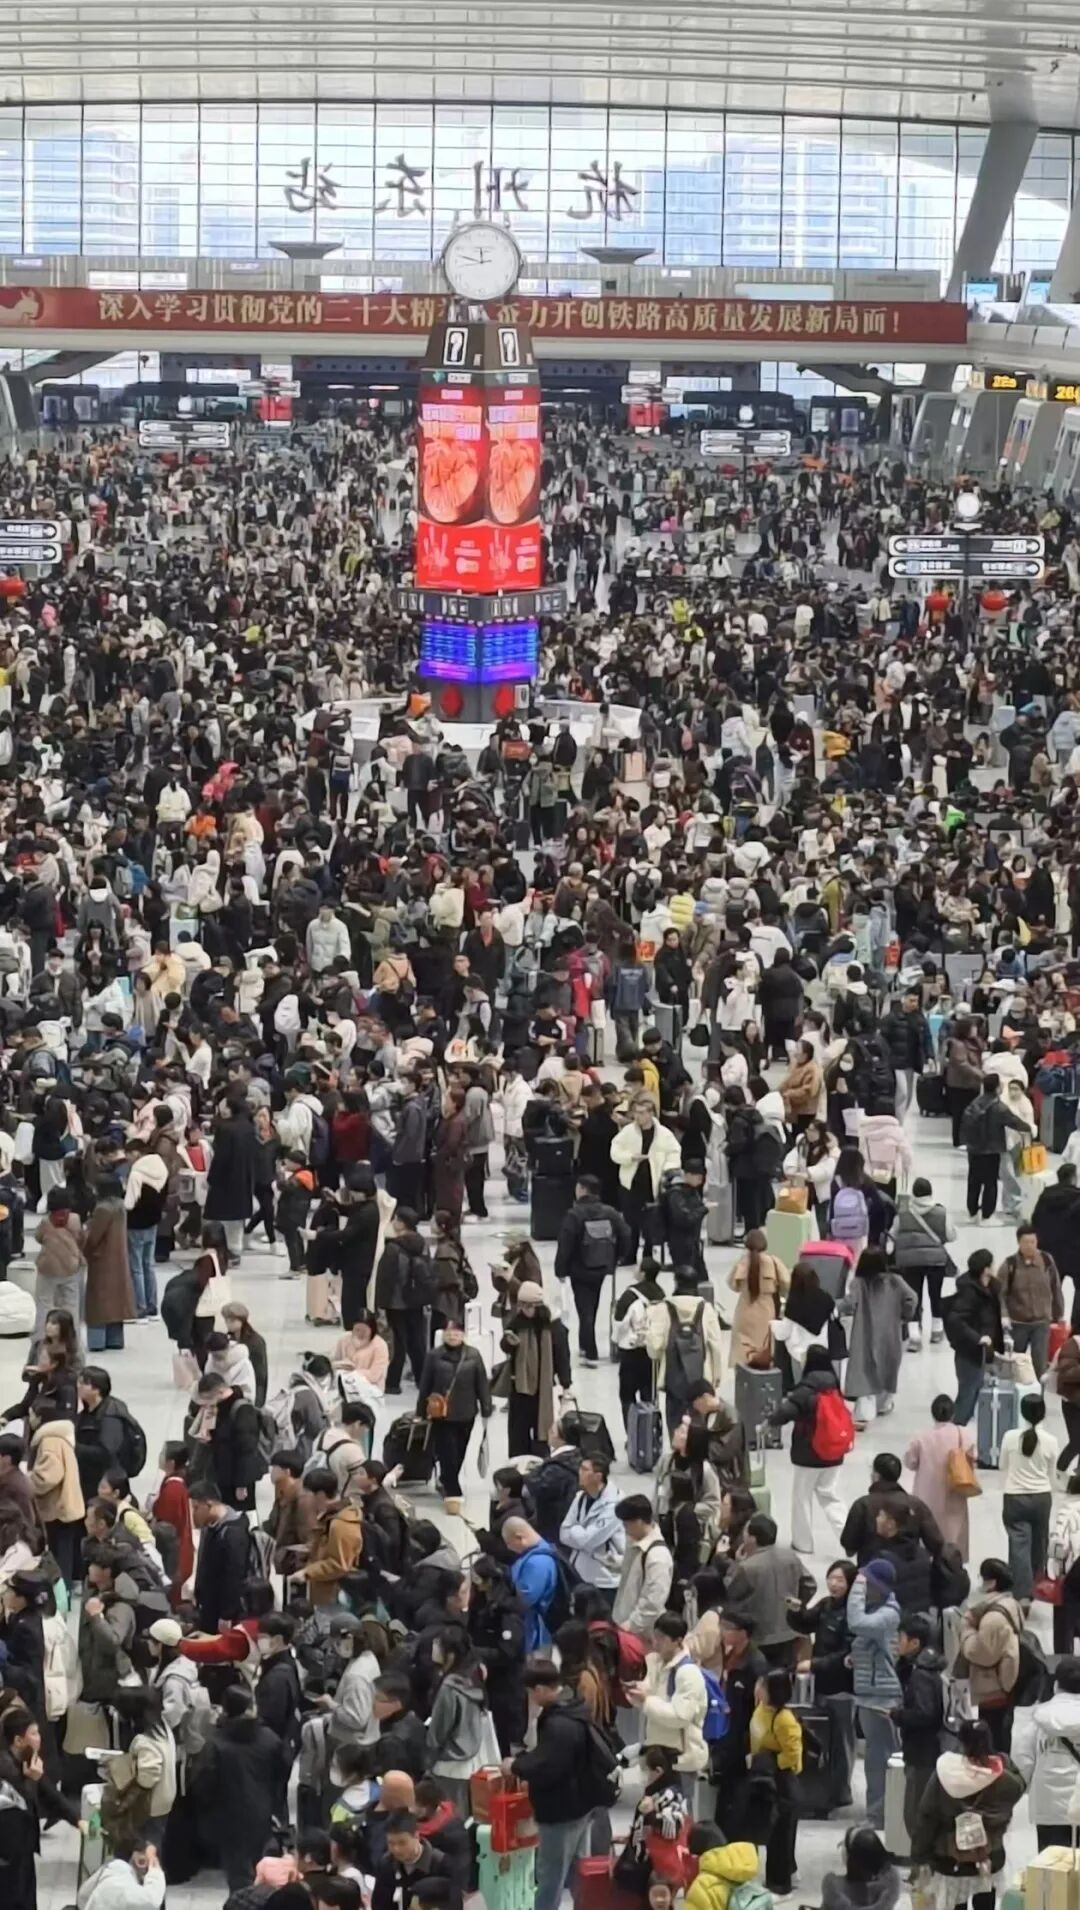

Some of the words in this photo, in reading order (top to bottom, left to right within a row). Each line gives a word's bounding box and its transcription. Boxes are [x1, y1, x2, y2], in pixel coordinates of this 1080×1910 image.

[98, 294, 446, 327] 深入学习贯彻党的二十大精
